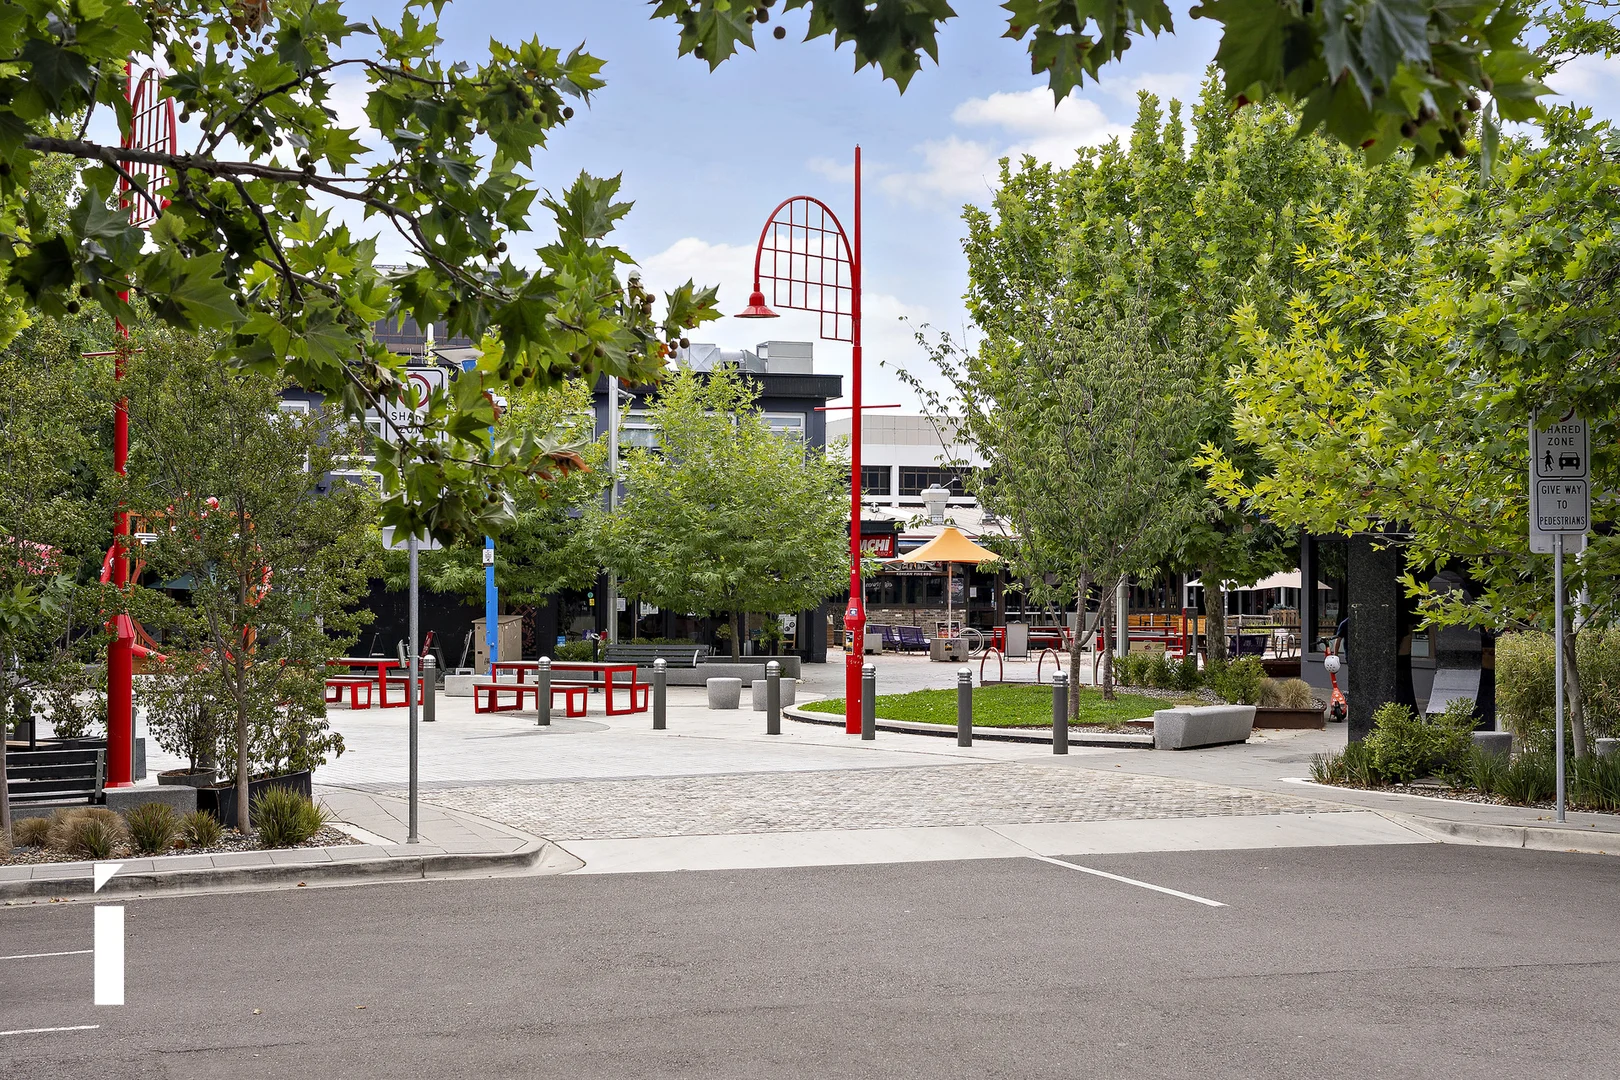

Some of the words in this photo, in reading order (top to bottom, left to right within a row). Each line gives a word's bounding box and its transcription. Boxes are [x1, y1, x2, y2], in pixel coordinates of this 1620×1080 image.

[1542, 425, 1581, 434] HARED
[1547, 437, 1575, 446] ZONE
[1541, 485, 1561, 495] GIVE
[1564, 485, 1582, 495] WAY
[1556, 500, 1568, 509] TO
[1539, 516, 1585, 526] PEDESTRIANS
